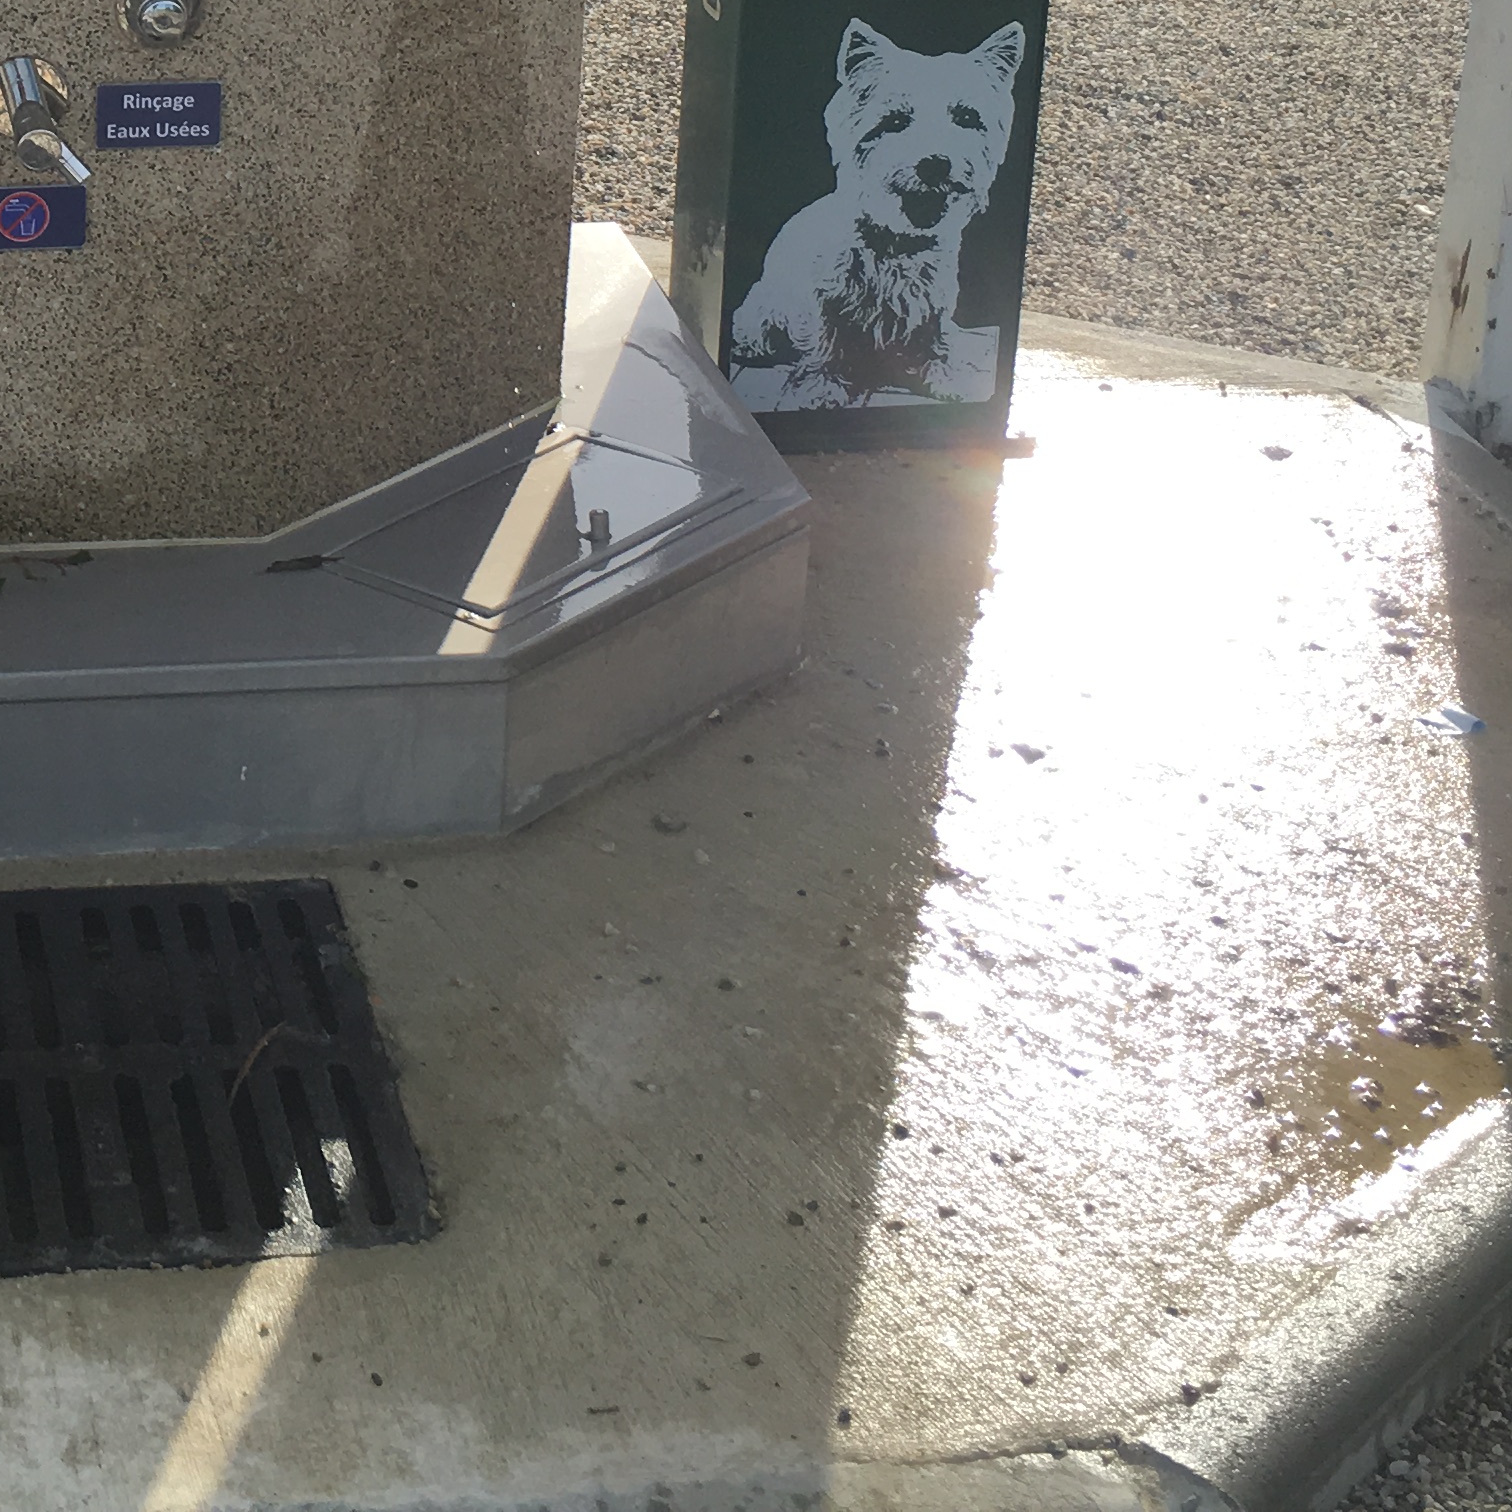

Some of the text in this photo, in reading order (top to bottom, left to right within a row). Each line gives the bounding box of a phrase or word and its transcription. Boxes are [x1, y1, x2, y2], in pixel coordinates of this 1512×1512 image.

[122, 93, 195, 114] Rinçage
[106, 120, 210, 140] Eaux Usées
